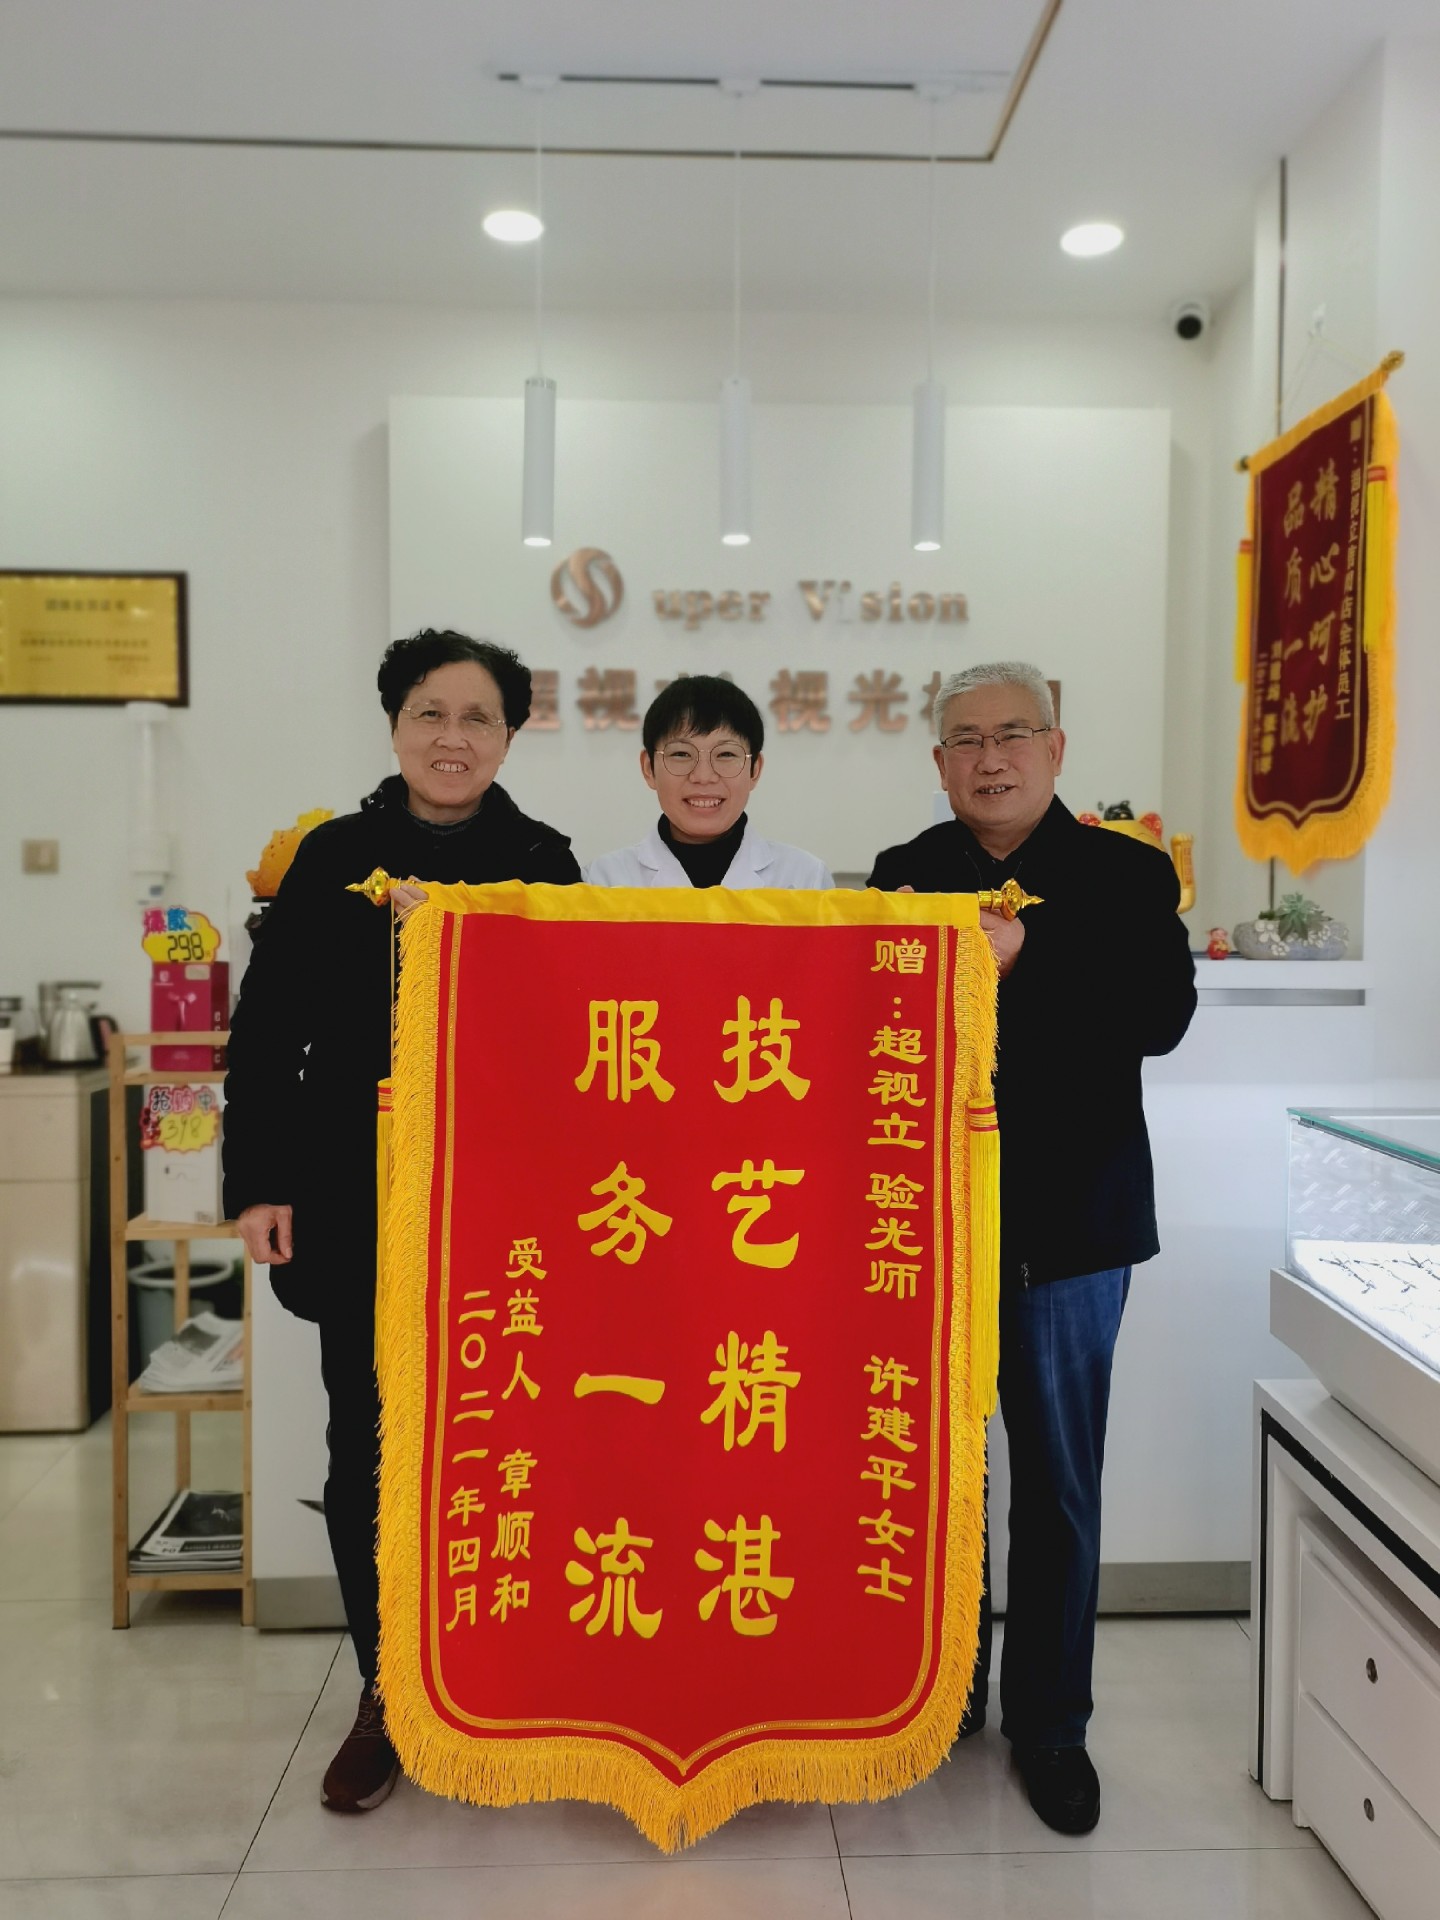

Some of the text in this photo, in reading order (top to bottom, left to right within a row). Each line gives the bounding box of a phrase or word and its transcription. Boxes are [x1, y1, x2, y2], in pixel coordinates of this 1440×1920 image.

[167, 932, 204, 964] 298
[490, 1238, 546, 1622] 受益人 章顺和
[565, 1000, 675, 1638] 服务一流
[695, 995, 810, 1635] 技艺精湛
[858, 1356, 918, 1601] 许建平女士
